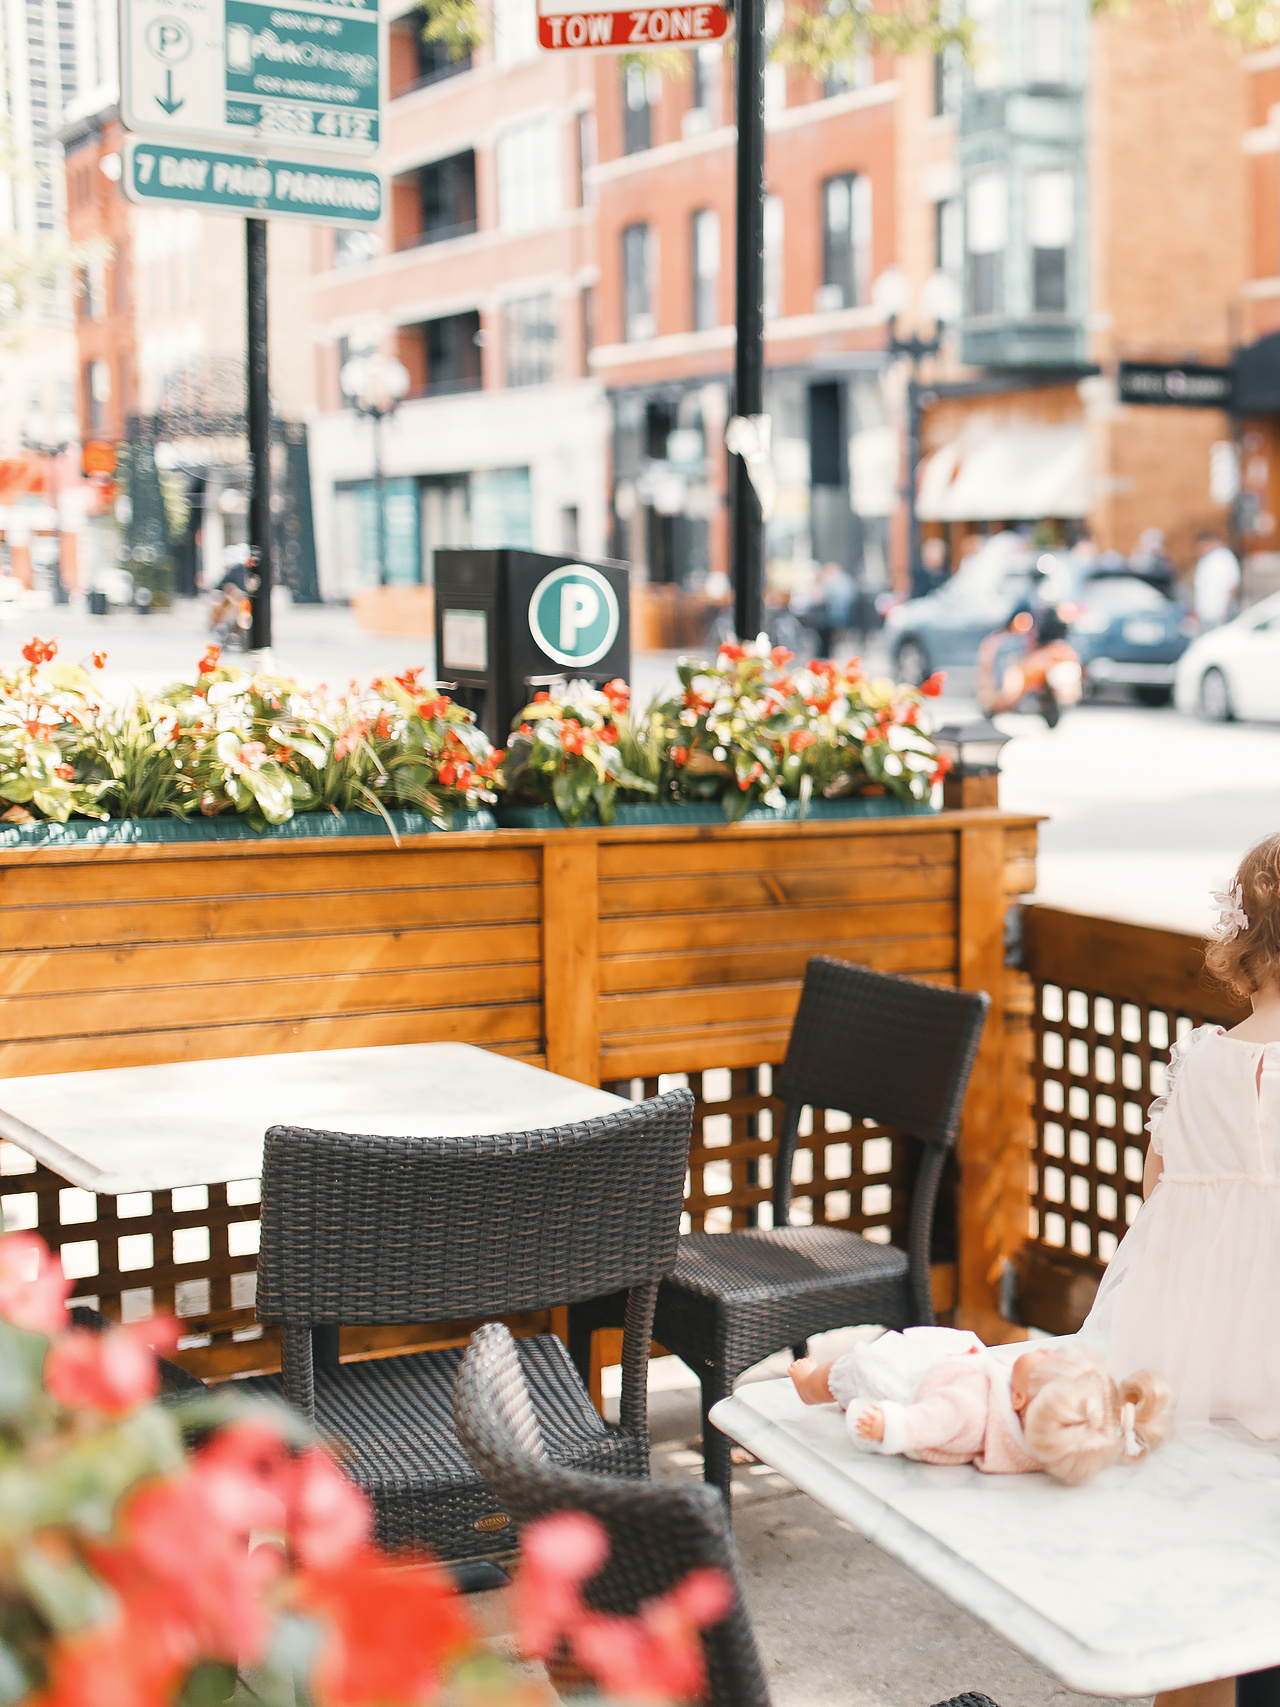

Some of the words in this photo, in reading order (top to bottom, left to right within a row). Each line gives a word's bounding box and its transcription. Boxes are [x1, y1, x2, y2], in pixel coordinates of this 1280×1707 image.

[160, 26, 182, 51] P
[547, 13, 613, 47] TOW
[628, 7, 713, 42] ZONE
[316, 110, 371, 140] 412
[136, 153, 155, 184] 7
[159, 154, 210, 191] DAY
[213, 161, 273, 199] PAID
[275, 169, 380, 212] PARKING
[560, 582, 600, 651] P
